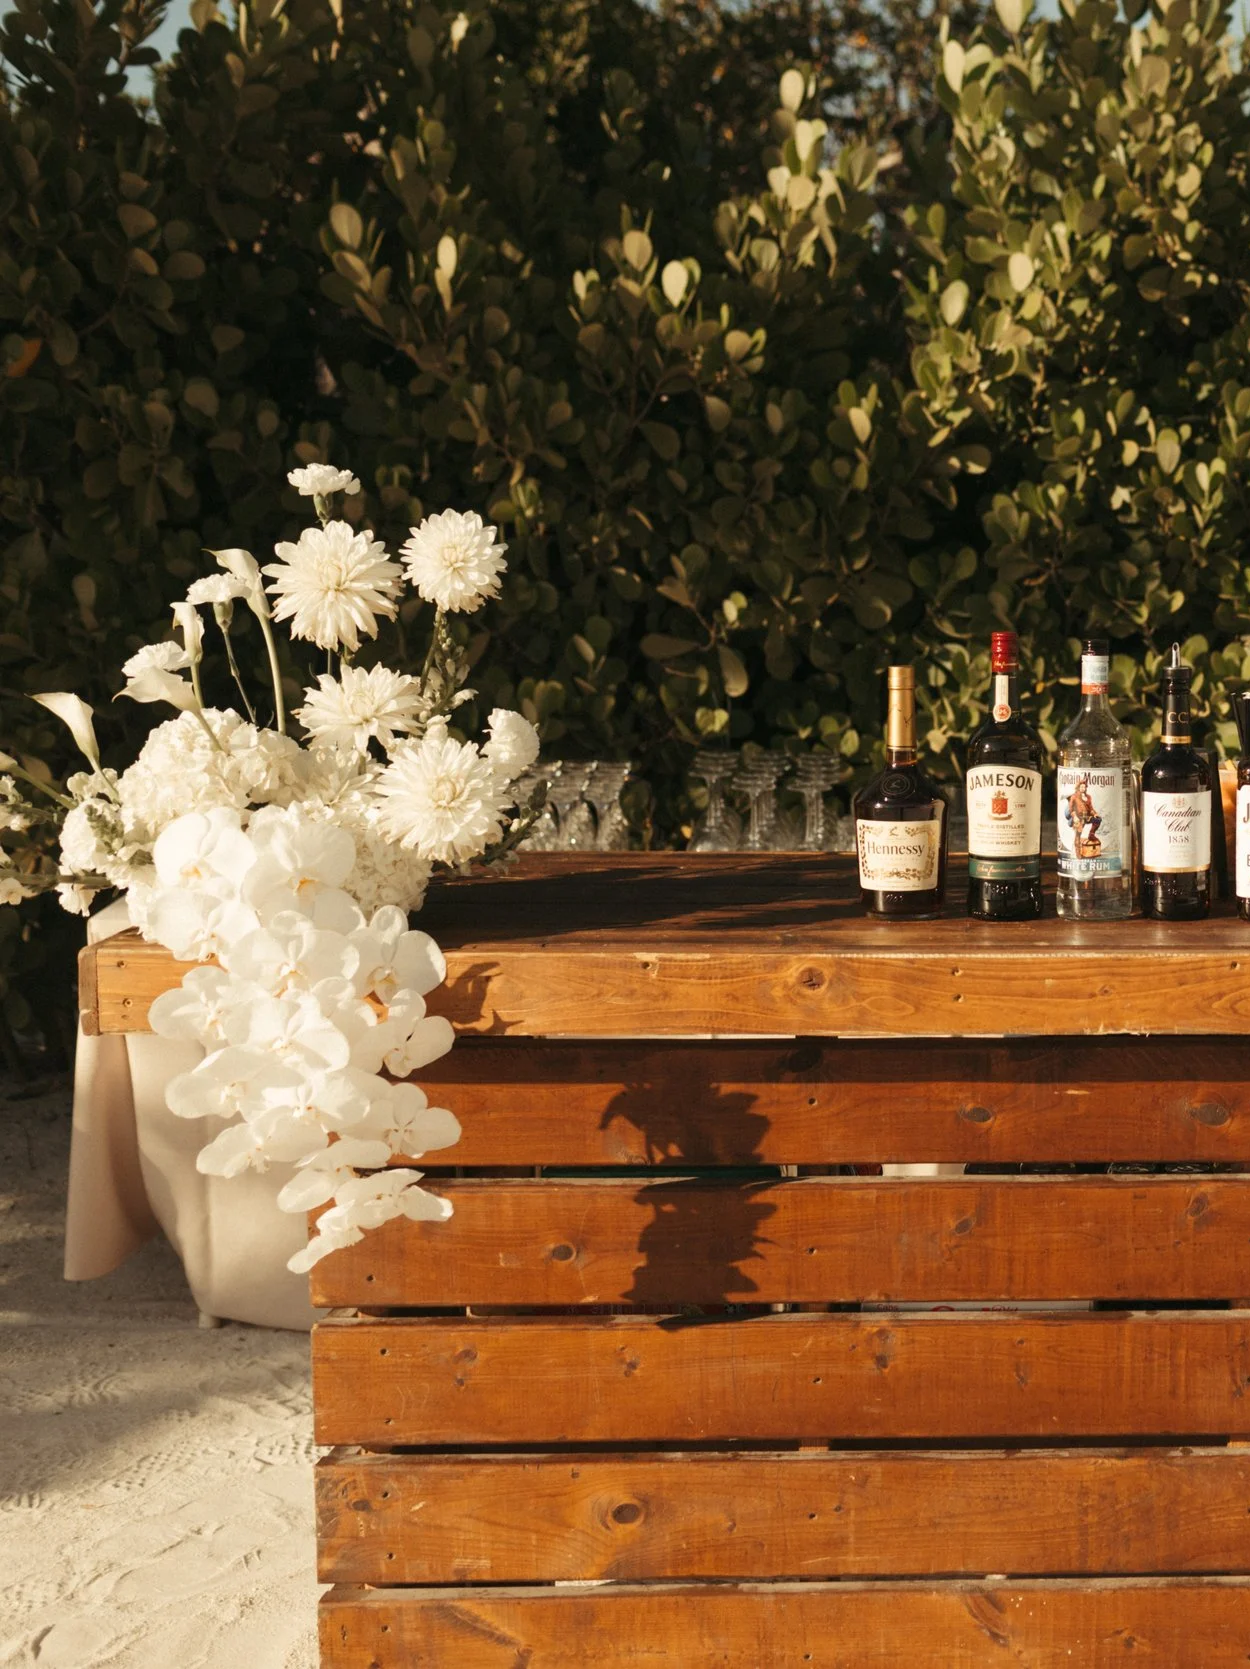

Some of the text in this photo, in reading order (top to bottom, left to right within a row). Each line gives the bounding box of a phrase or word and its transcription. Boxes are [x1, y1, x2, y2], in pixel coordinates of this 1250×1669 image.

[970, 773, 1035, 791] JAMESON
[1083, 771, 1115, 788] Morgan
[1154, 803, 1202, 818] Canadian
[1164, 818, 1192, 832] Club
[1168, 835, 1190, 844] 1858
[867, 841, 926, 857] Hennessy
[1061, 859, 1087, 871] WHITE
[1090, 860, 1110, 871] RUM
